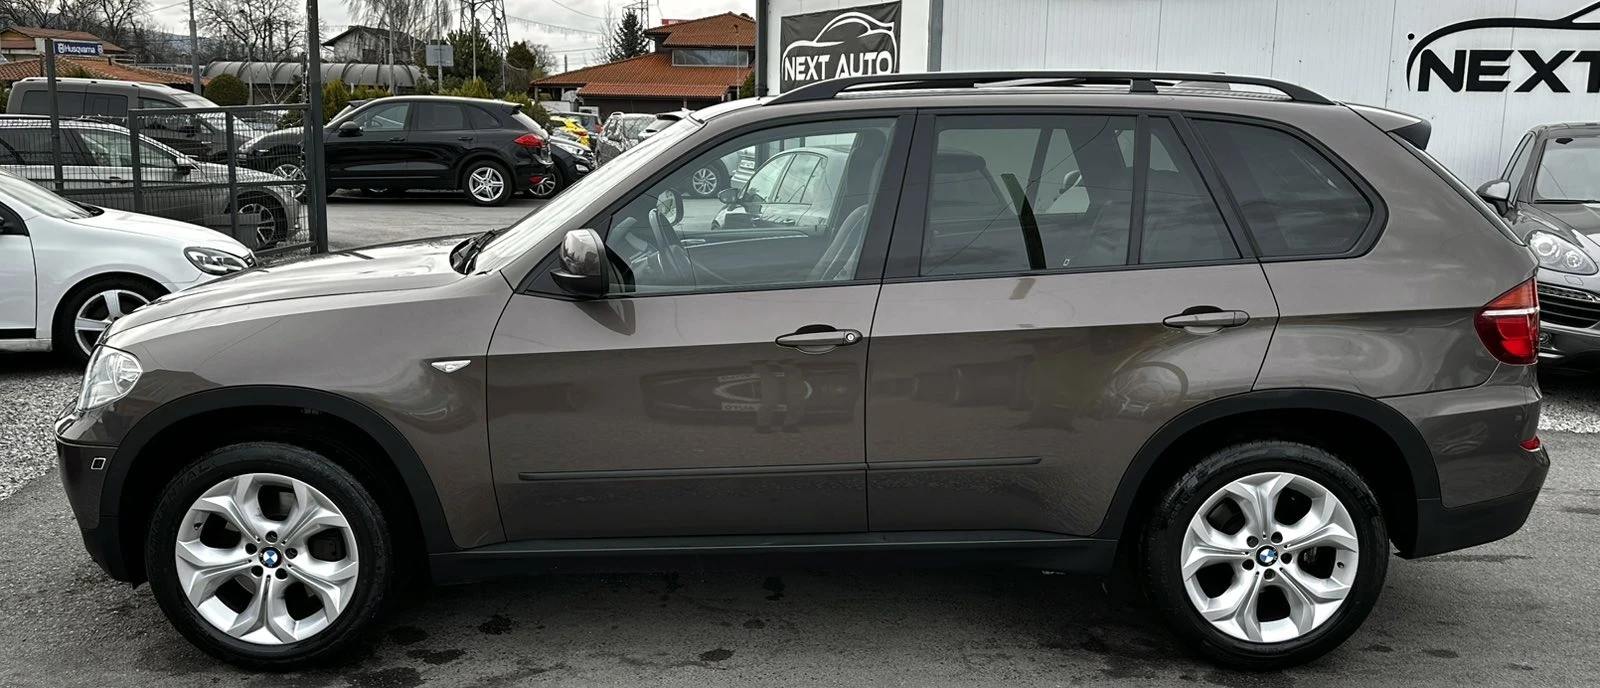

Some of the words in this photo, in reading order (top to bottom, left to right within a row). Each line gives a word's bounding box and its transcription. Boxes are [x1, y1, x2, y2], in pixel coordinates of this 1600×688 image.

[784, 55, 831, 81] NEXT
[834, 50, 893, 79] AUTO
[1417, 49, 1600, 93] NEXT
